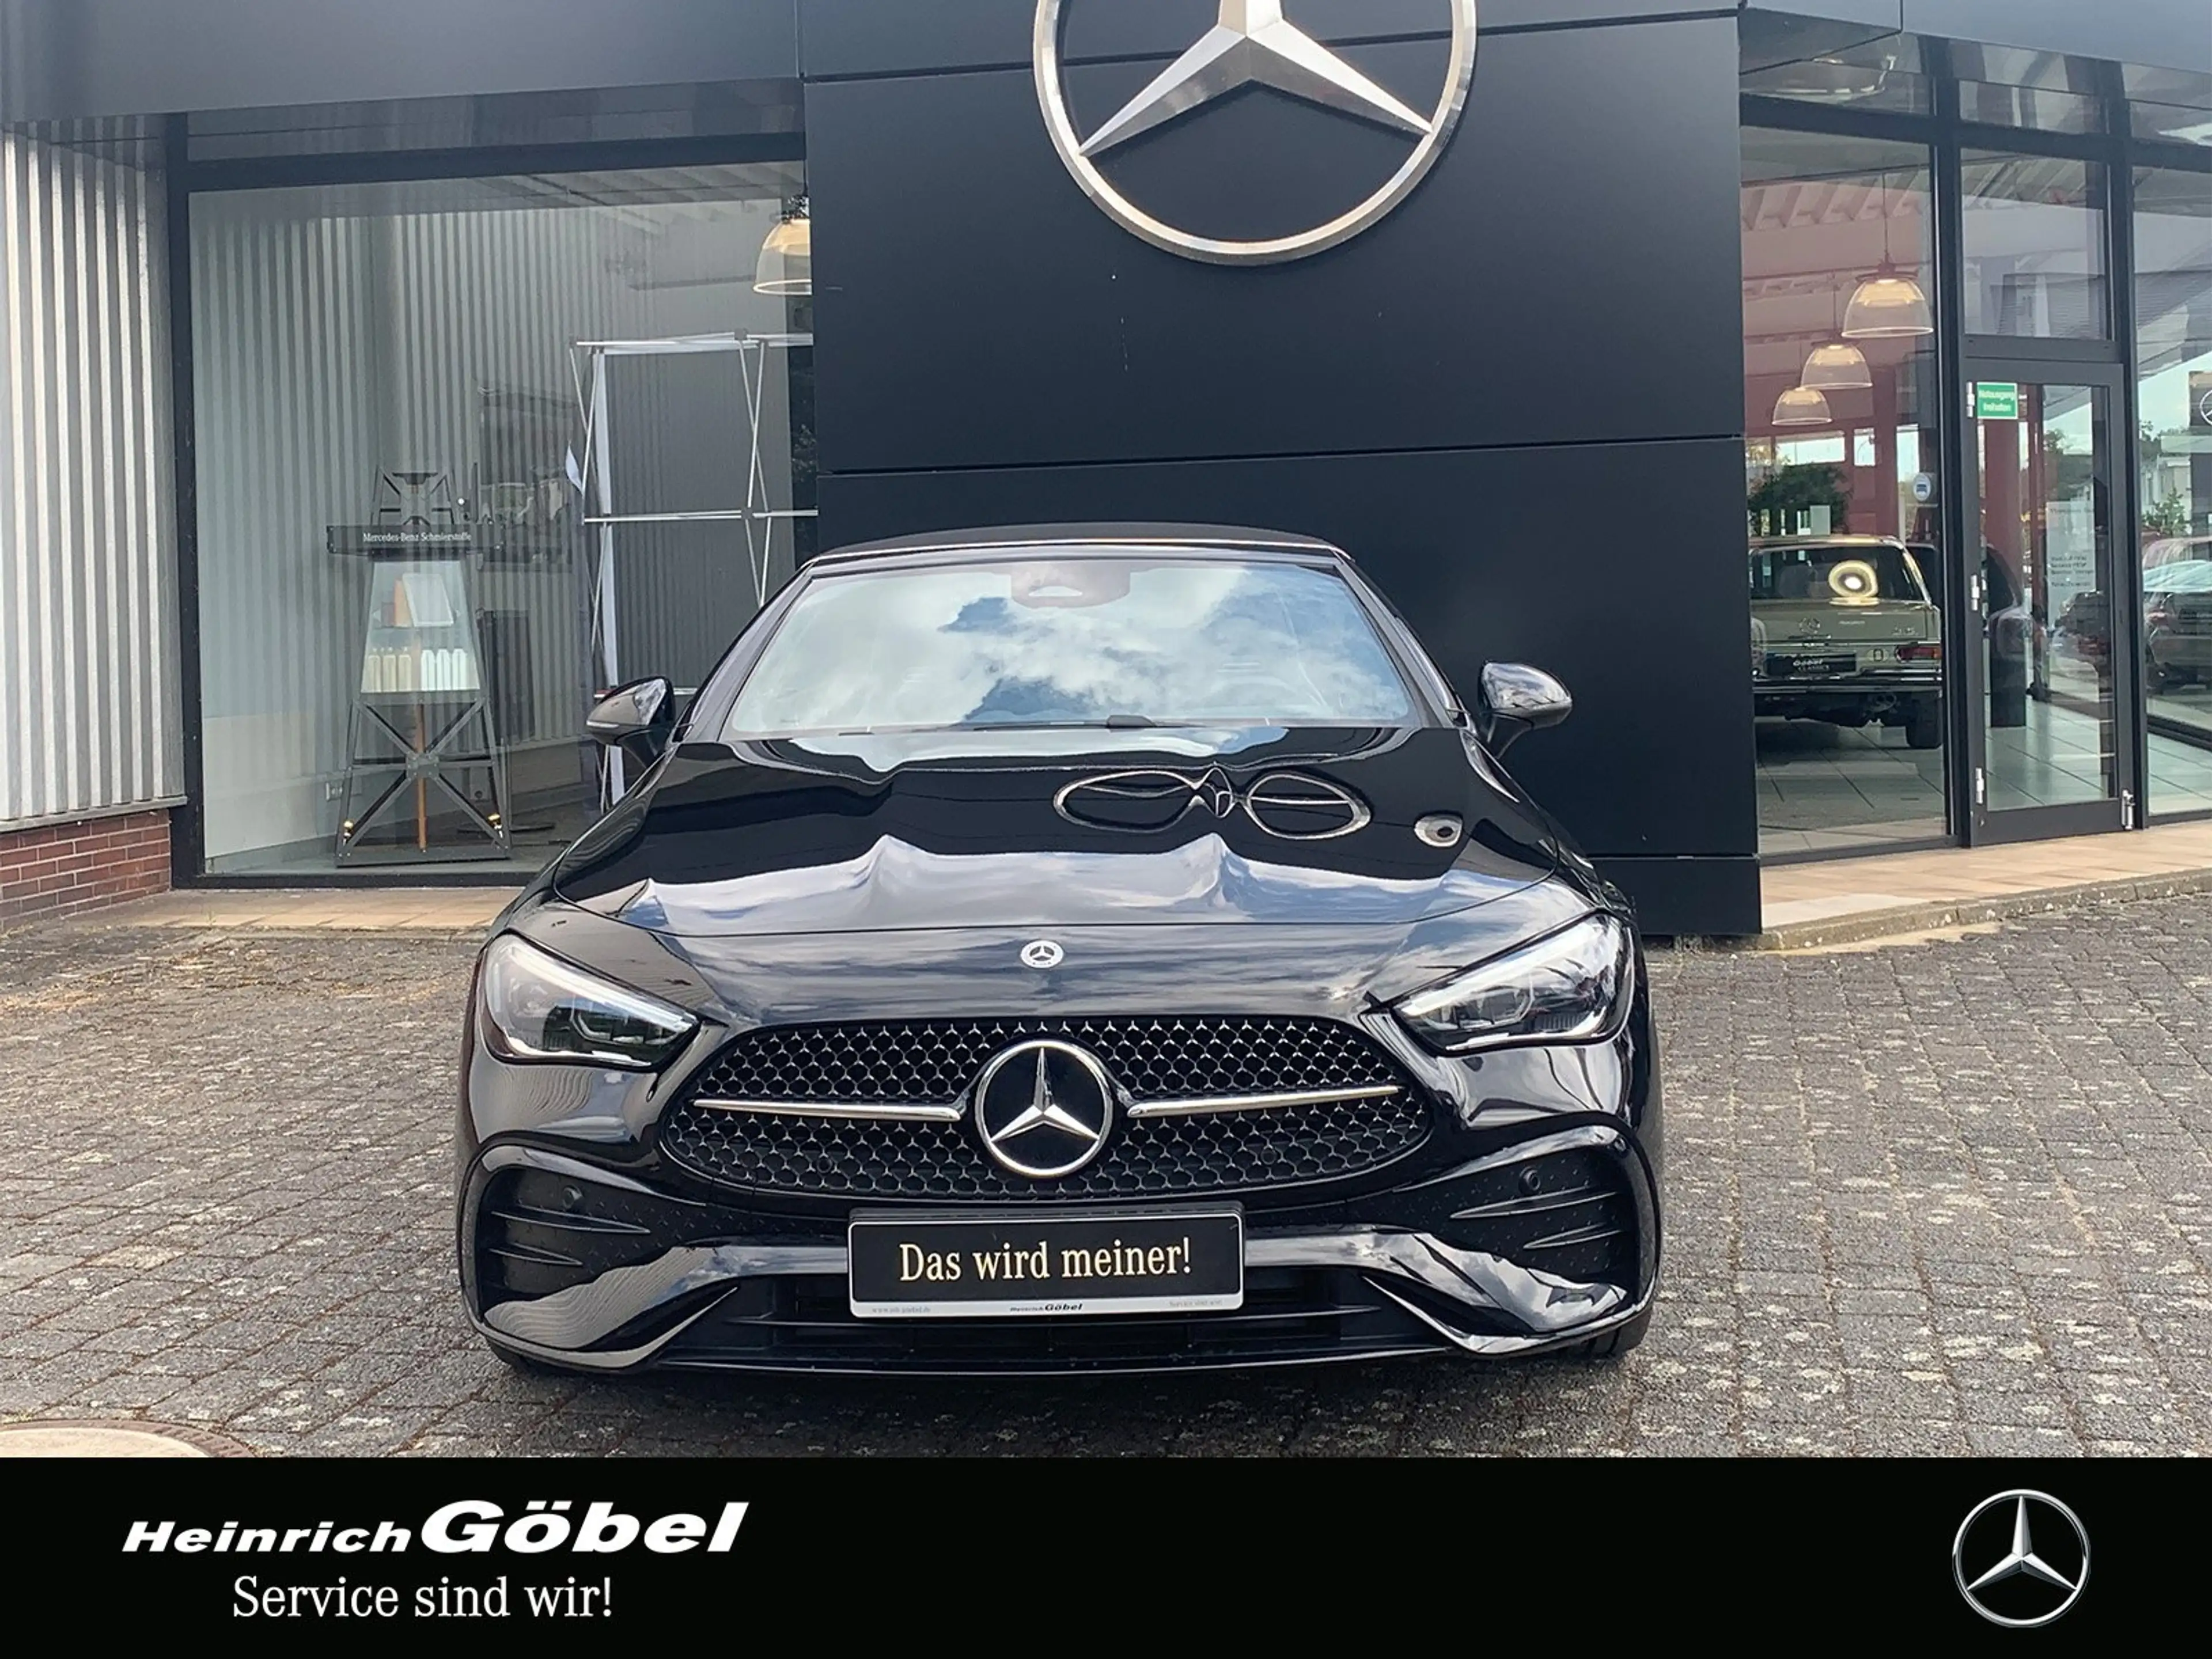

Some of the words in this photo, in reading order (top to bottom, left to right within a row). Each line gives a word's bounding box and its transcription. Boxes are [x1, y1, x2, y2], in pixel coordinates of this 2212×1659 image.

[363, 532, 419, 542] Mercedes-Benz
[421, 532, 472, 541] Schmierstoffe
[899, 1243, 961, 1281] Das
[972, 1241, 1050, 1280] wird
[1061, 1236, 1191, 1278] meiner!
